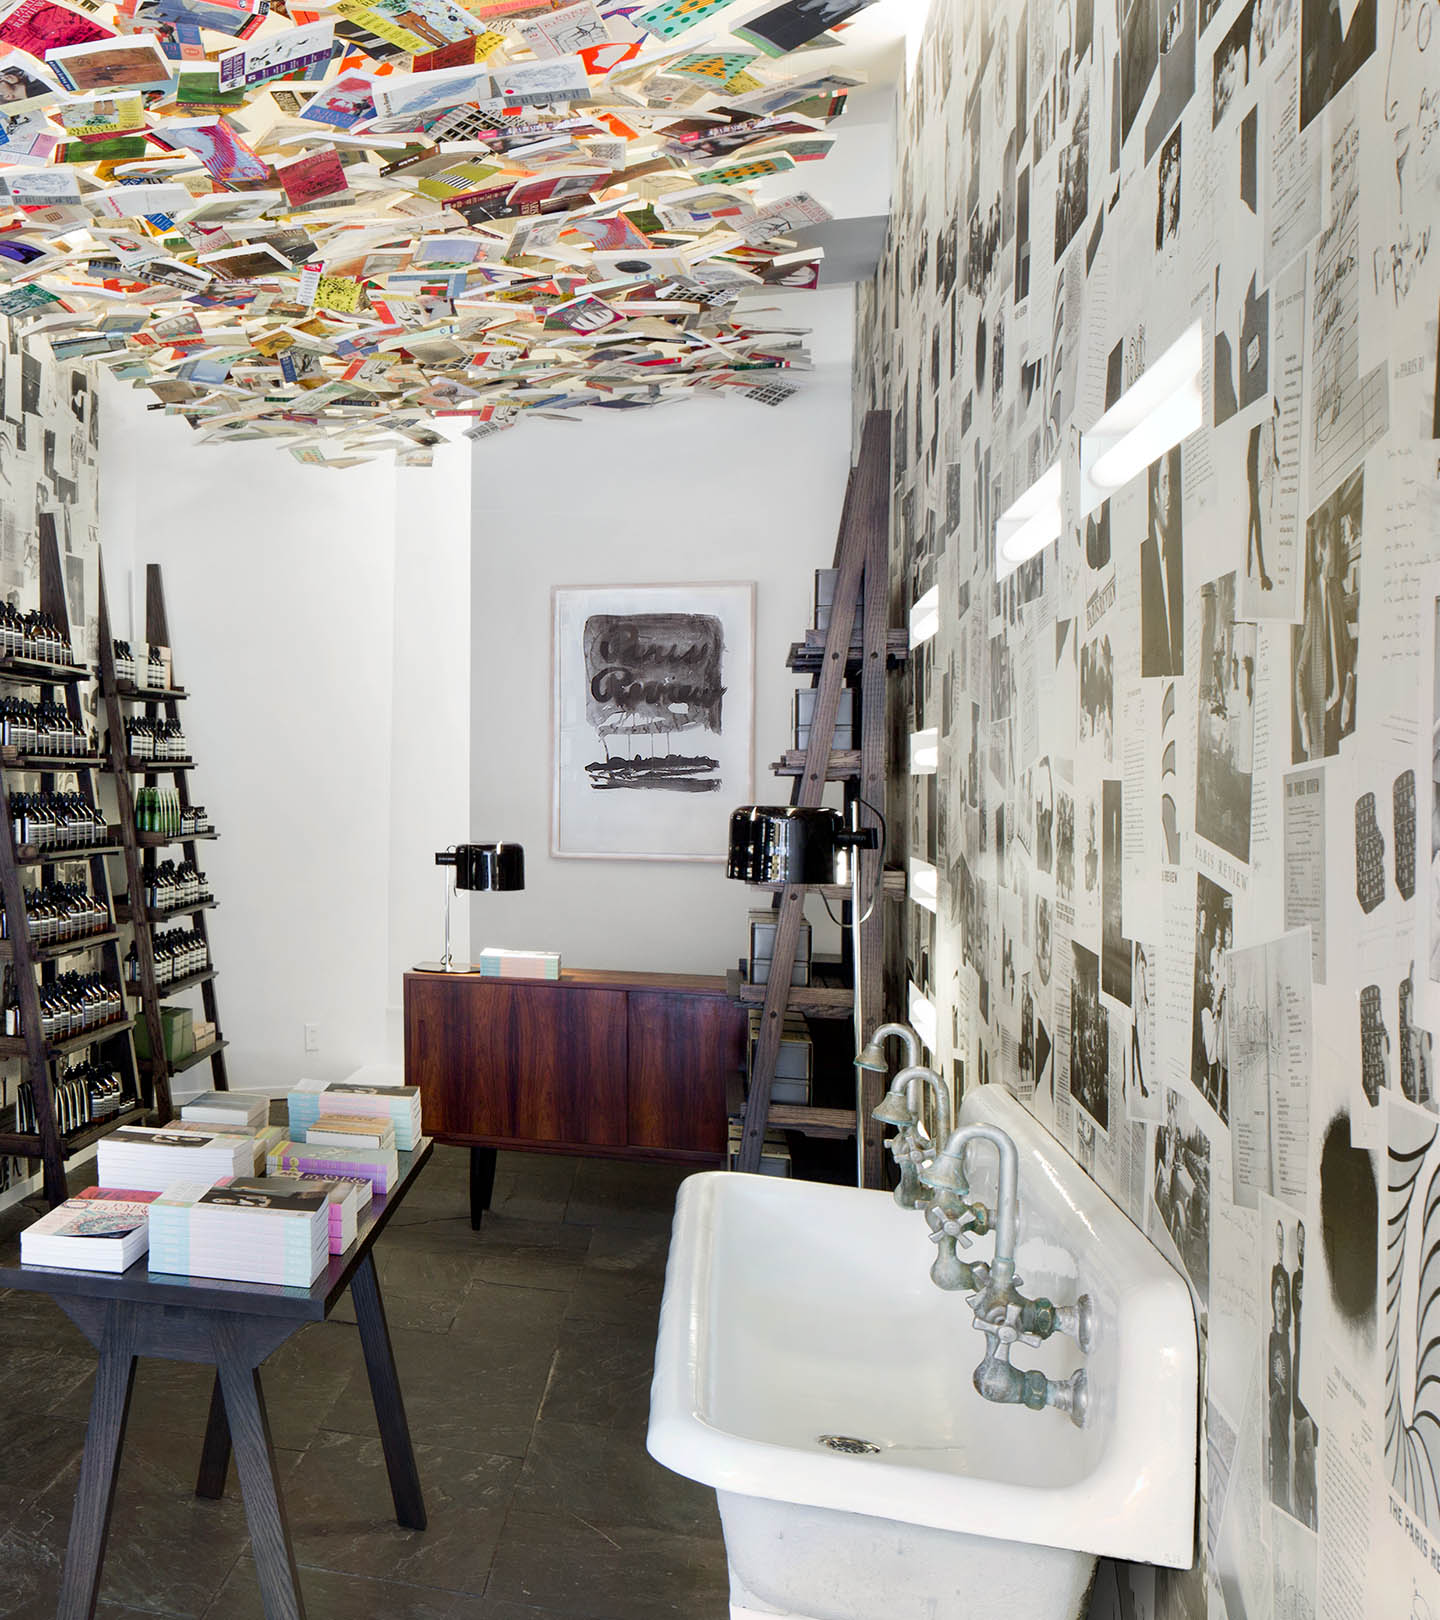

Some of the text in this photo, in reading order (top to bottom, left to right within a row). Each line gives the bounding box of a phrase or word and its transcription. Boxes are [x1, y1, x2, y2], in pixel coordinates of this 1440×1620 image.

[1194, 841, 1250, 891] PARIS REVIEW
[1388, 1494, 1403, 1528] THE
[1404, 1516, 1429, 1559] PARIS
